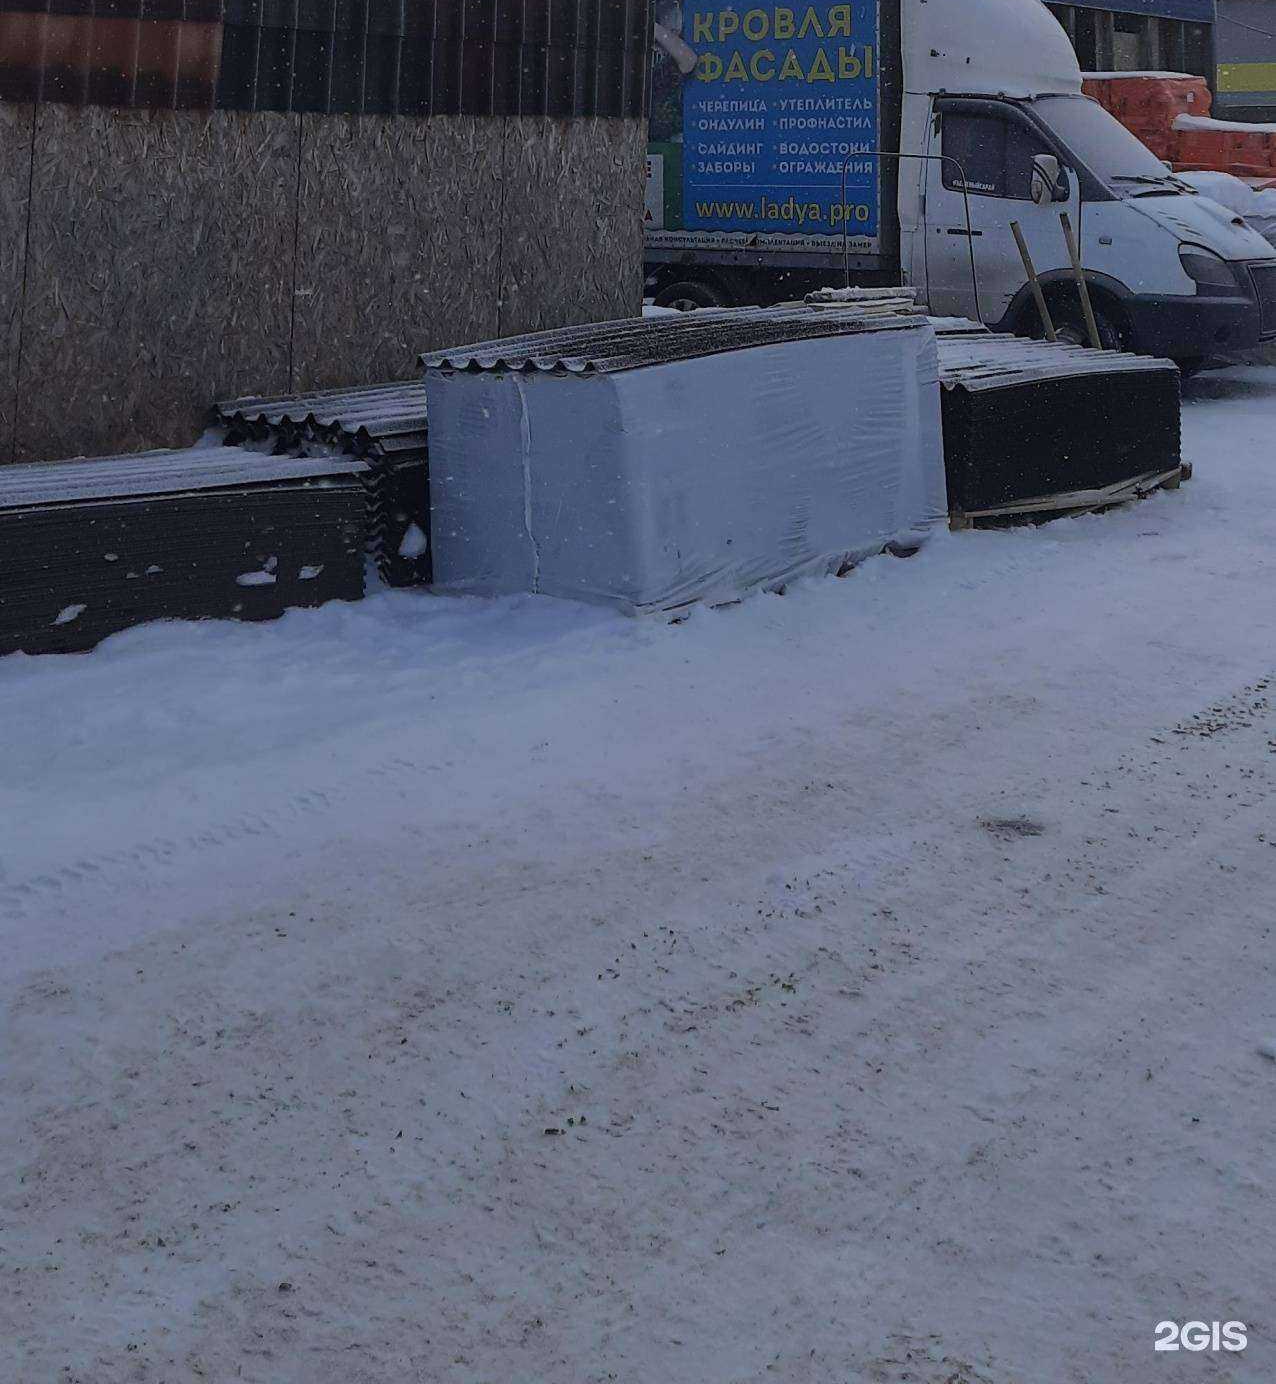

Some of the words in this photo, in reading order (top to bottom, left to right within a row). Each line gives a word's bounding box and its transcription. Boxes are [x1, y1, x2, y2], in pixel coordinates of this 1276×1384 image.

[693, 4, 852, 43] КРОВЛЯ
[697, 46, 874, 83] ФАСАДЫ
[699, 99, 767, 113] ЧЕРЕПИЦА
[779, 97, 873, 111] УТЕПЛИТЕЛЬ
[699, 118, 765, 131] ОНДУЛИН
[779, 116, 872, 130] ПРОФНАСТИЛ
[699, 141, 764, 156] САЙДИНГ
[779, 142, 872, 155] ВОДОСТОКИ
[698, 161, 755, 174] ЗАБОРЫ
[779, 160, 873, 174] ОГРАЖДЕНИЯ
[696, 196, 870, 226] www.ladya.pro
